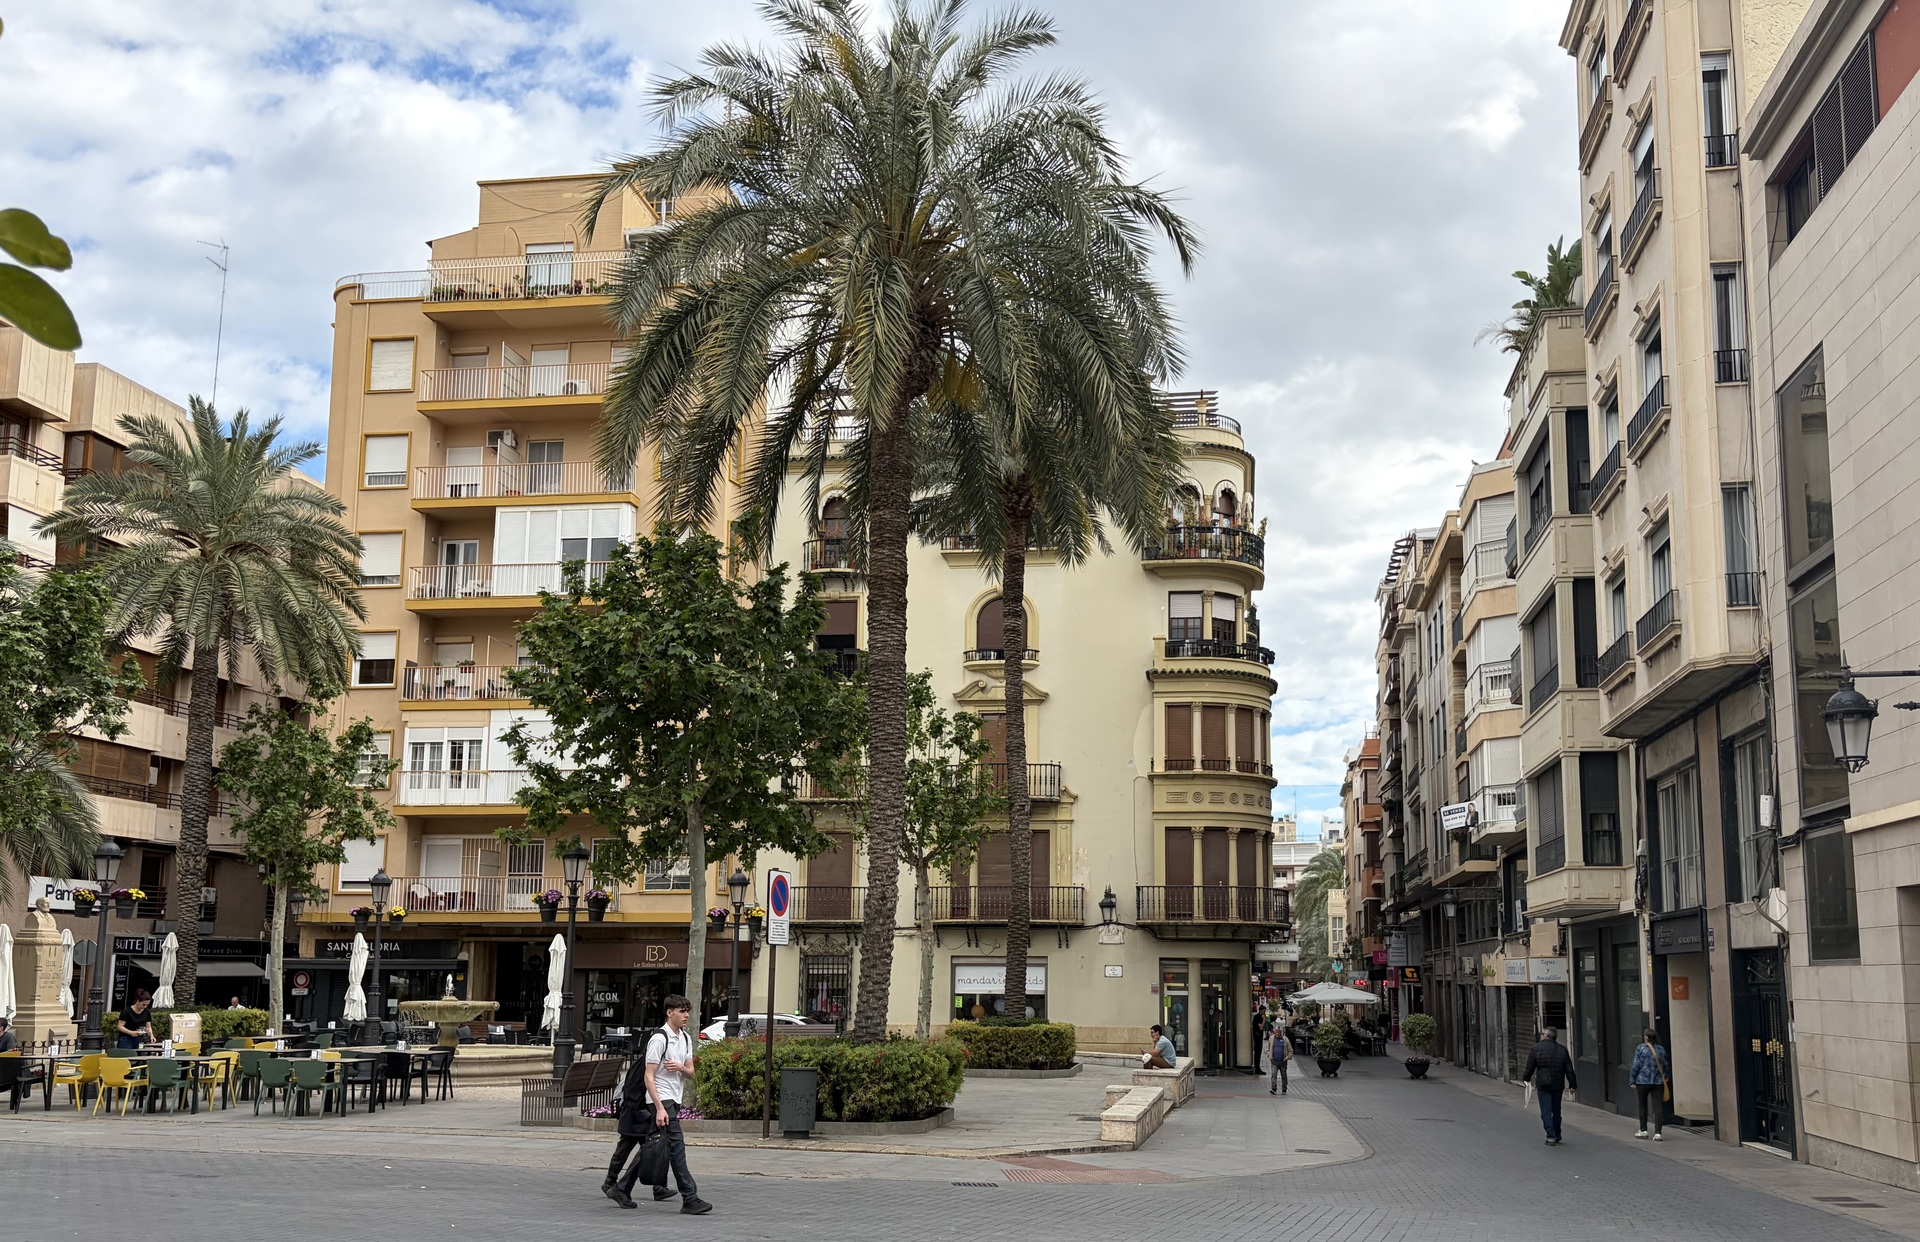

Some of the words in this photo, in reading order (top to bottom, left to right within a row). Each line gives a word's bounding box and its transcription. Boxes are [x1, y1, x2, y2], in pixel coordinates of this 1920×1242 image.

[45, 884, 75, 901] Pam
[327, 942, 355, 951] SANT
[367, 942, 400, 951] LRIA
[957, 973, 1006, 985] mandari
[1026, 975, 1044, 985] ids
